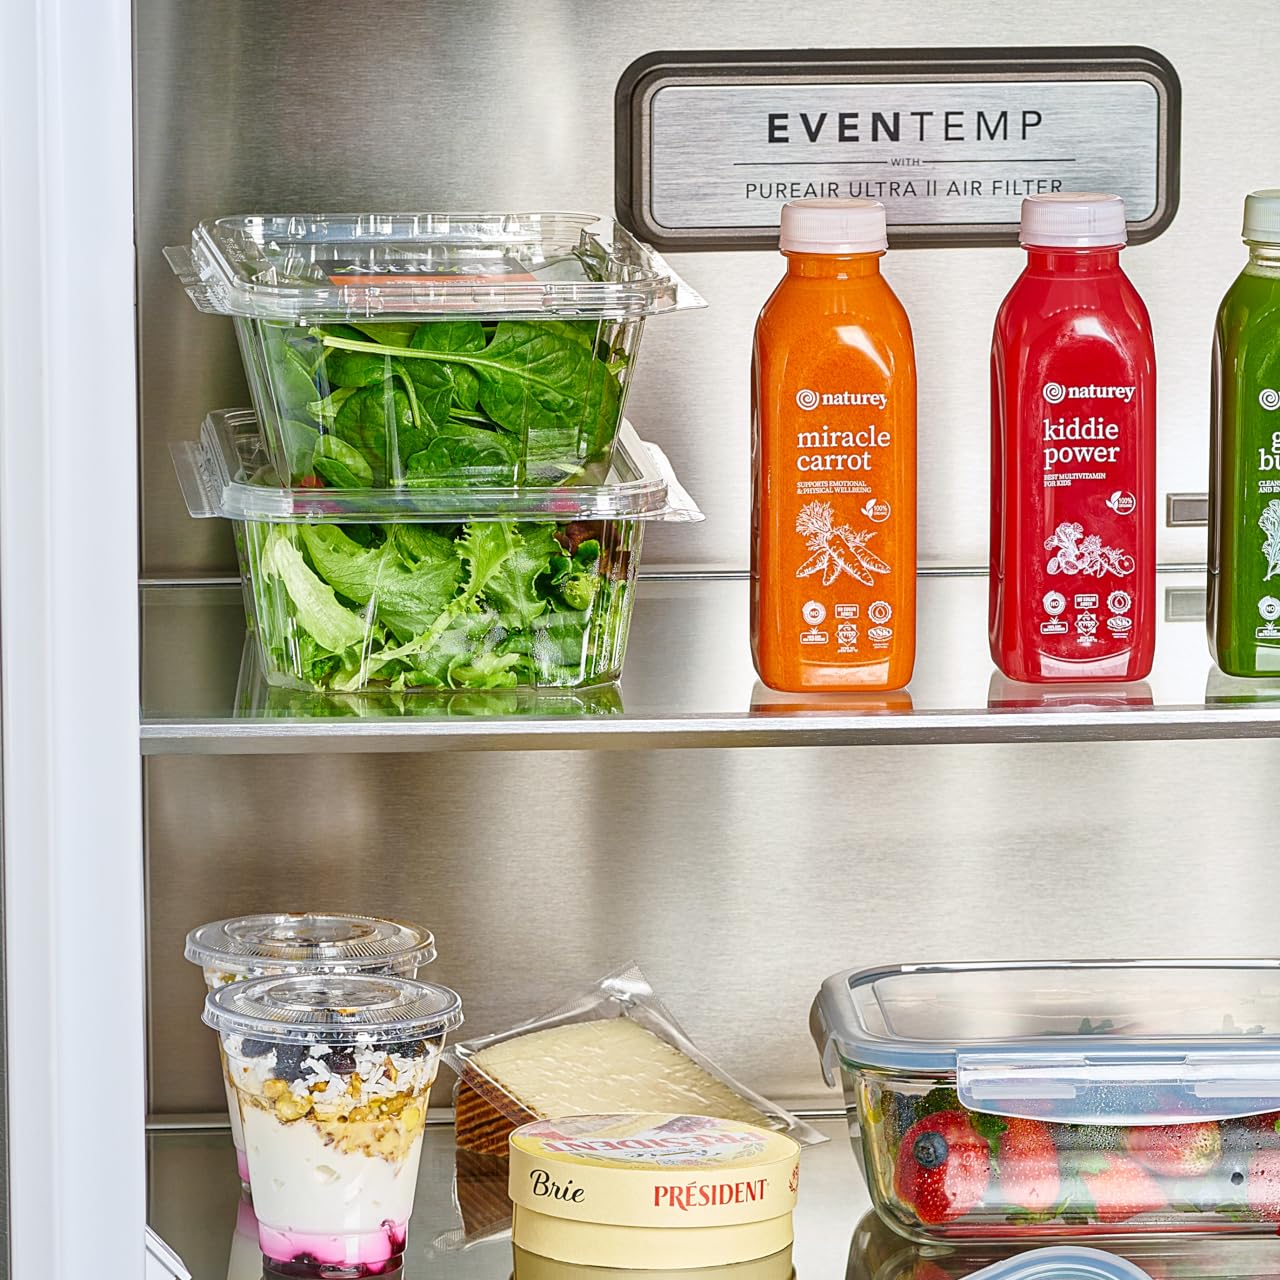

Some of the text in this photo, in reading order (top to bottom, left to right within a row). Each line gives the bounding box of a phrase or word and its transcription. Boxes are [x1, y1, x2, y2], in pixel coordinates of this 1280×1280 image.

[767, 110, 1044, 144] EVENTEMP
[890, 157, 921, 167] WITH
[745, 181, 840, 200] PUREAIR
[848, 180, 918, 198] ULTRA
[950, 179, 984, 198] AIR
[991, 178, 1064, 197] FILTER
[821, 391, 888, 410] naturey
[1067, 384, 1137, 403] naturey
[796, 425, 892, 449] miracle
[1042, 416, 1120, 441] kiddie
[796, 450, 872, 472] carrot
[1043, 445, 1121, 471] power
[803, 487, 834, 495] PHYSICAL
[834, 486, 872, 494] WELLBEING
[828, 480, 867, 488] EMOTIONAL
[1056, 479, 1072, 487] KIDS
[529, 1168, 586, 1204] Brie
[653, 1178, 769, 1212] PRÉSIDENT
